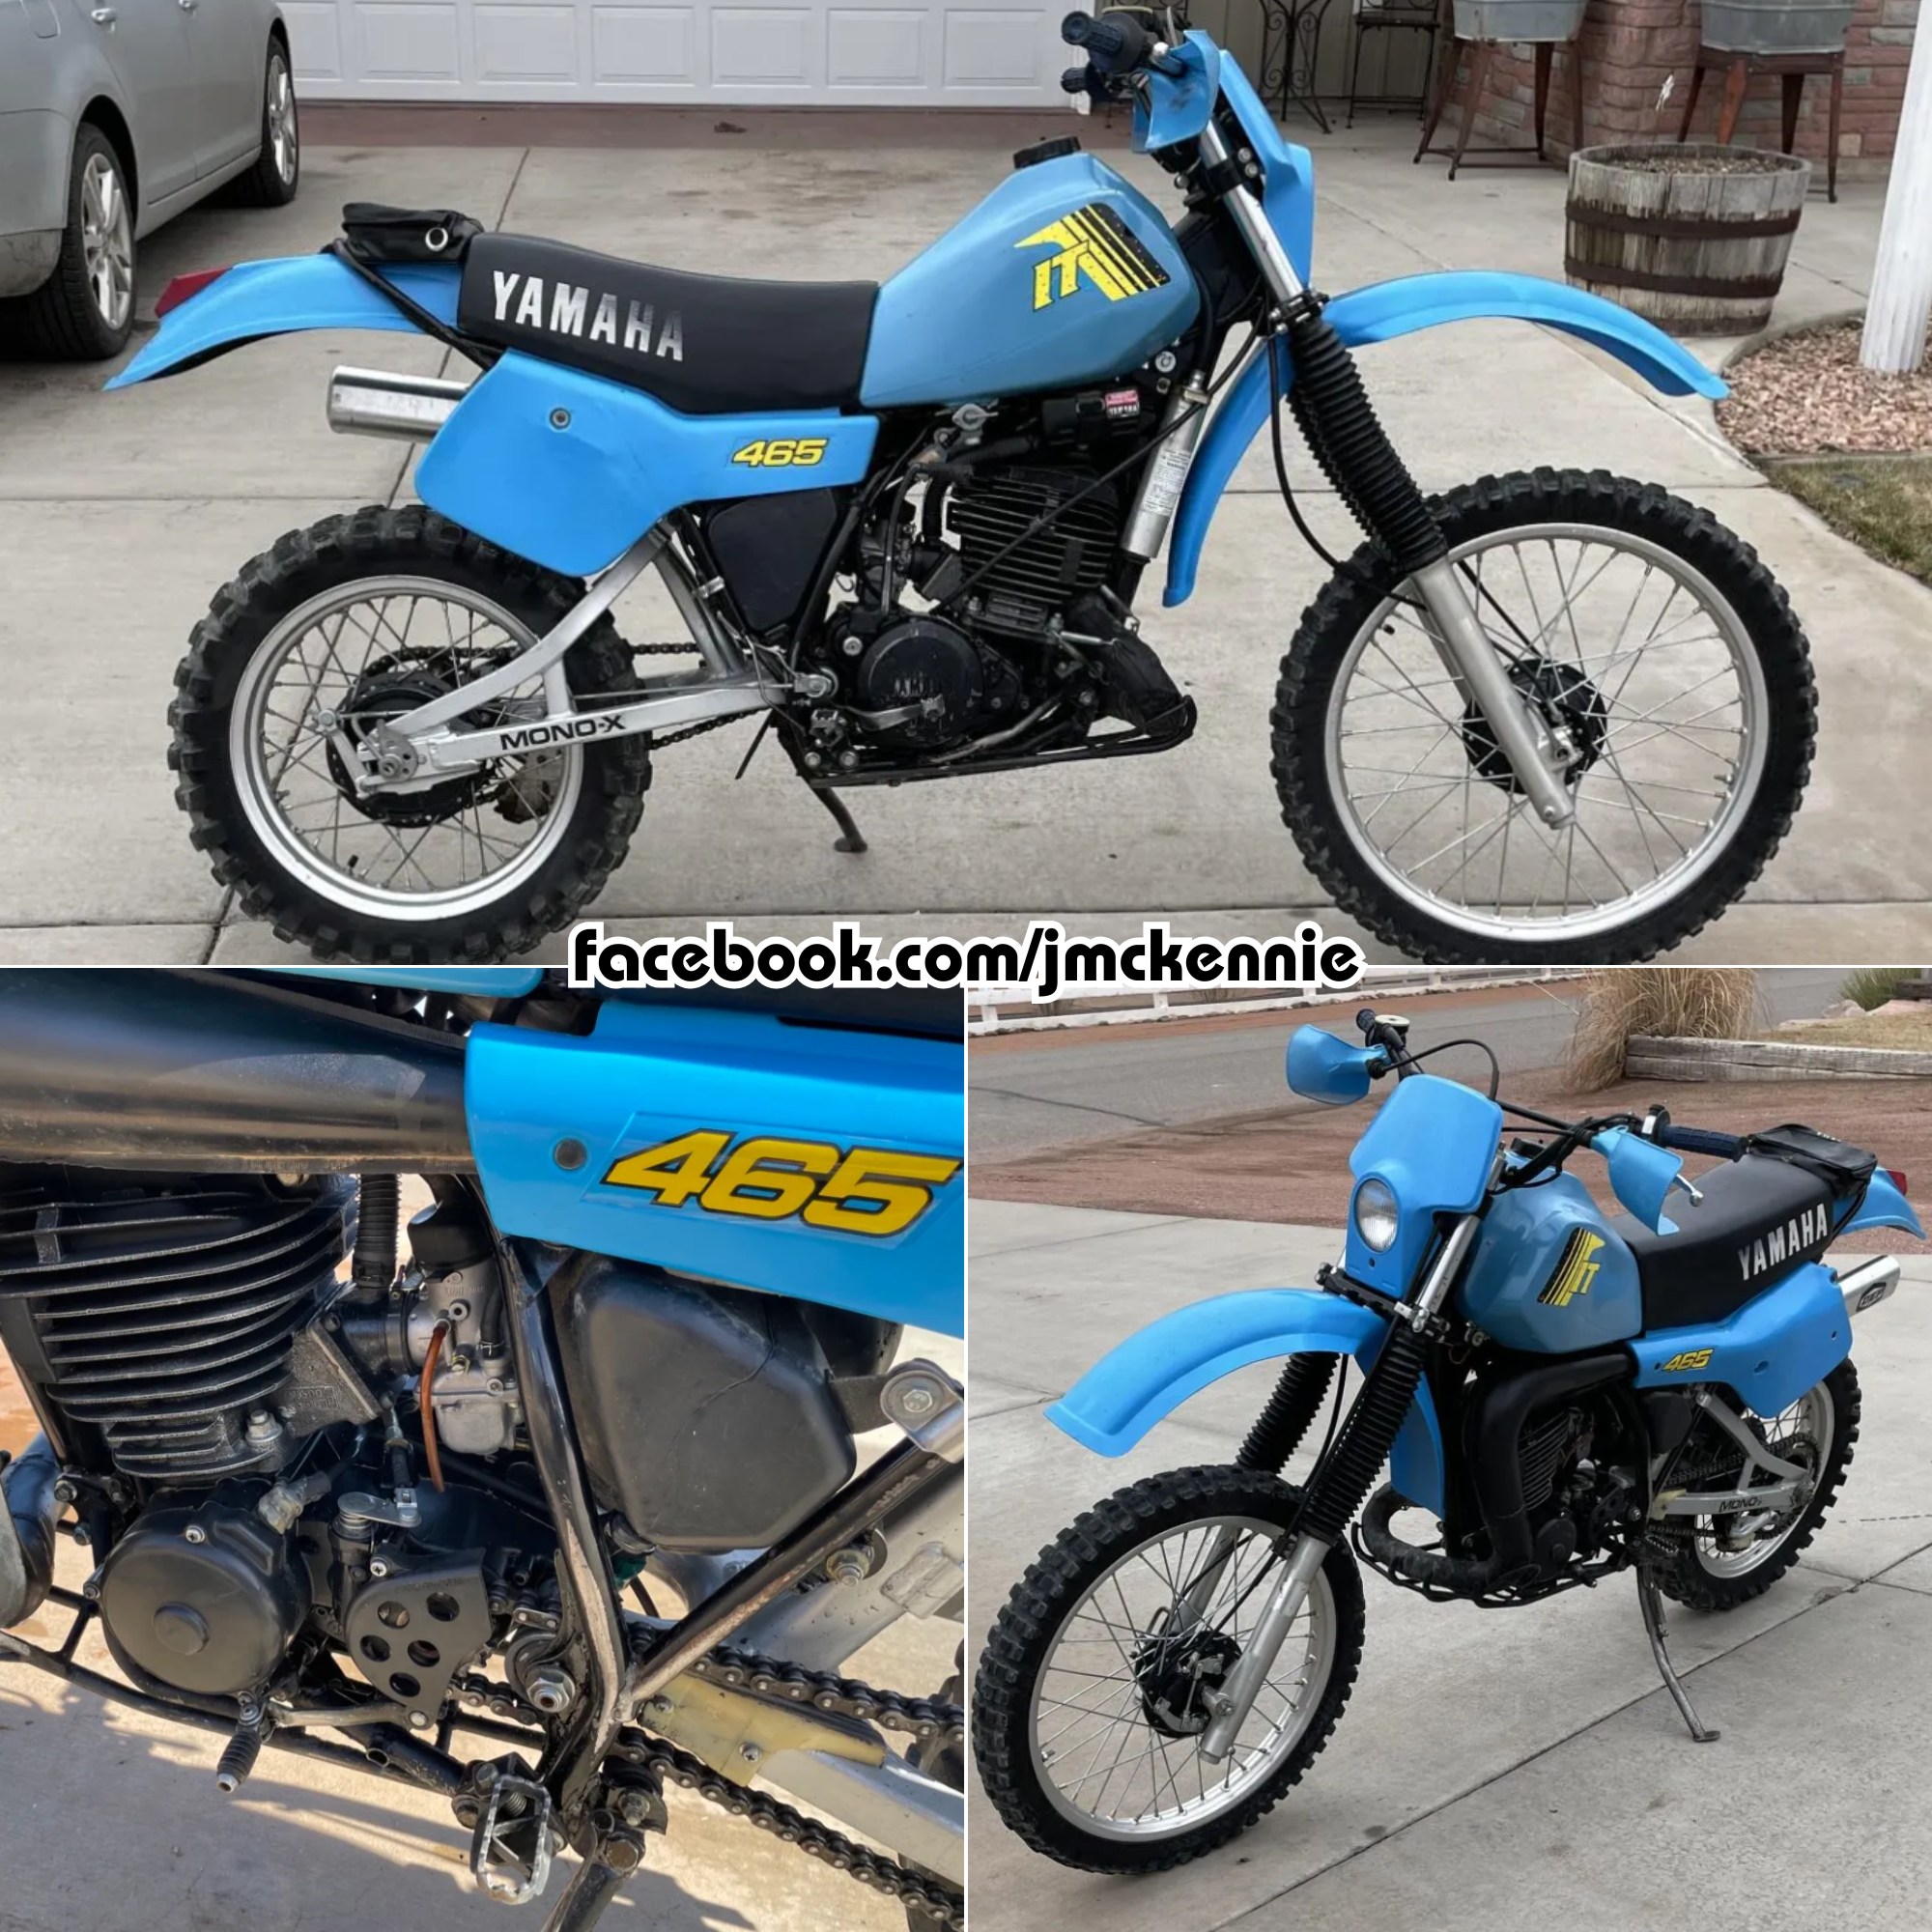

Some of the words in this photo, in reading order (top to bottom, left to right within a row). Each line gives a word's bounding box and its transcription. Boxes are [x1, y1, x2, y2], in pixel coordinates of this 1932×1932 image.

[493, 270, 684, 362] YAMAHA
[731, 438, 830, 468] 465
[499, 715, 626, 751] MONO-X
[599, 1127, 964, 1239] 465
[1737, 1203, 1829, 1281] YAMAHA
[1662, 1348, 1715, 1373] 465
